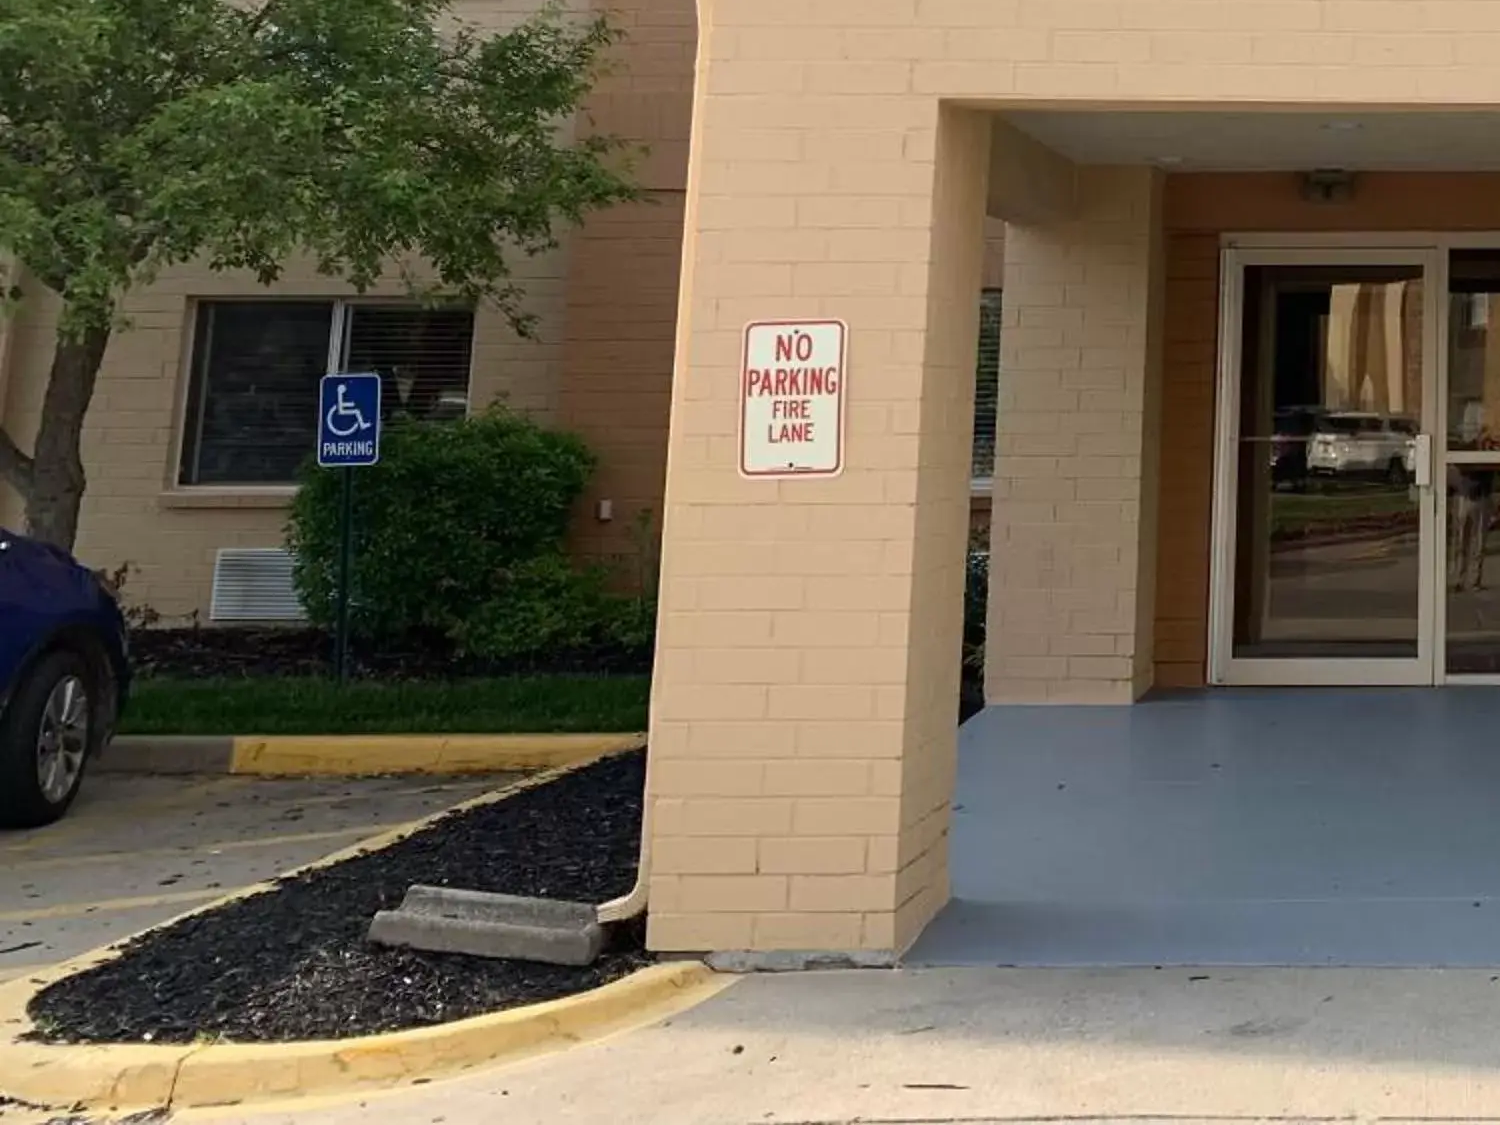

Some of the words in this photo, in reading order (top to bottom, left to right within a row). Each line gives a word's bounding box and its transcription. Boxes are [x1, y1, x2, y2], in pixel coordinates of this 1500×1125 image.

[775, 334, 812, 362] NO
[748, 367, 837, 397] PARKING
[772, 400, 811, 419] FIRE
[768, 423, 815, 443] LANE
[323, 440, 373, 457] PARKING
